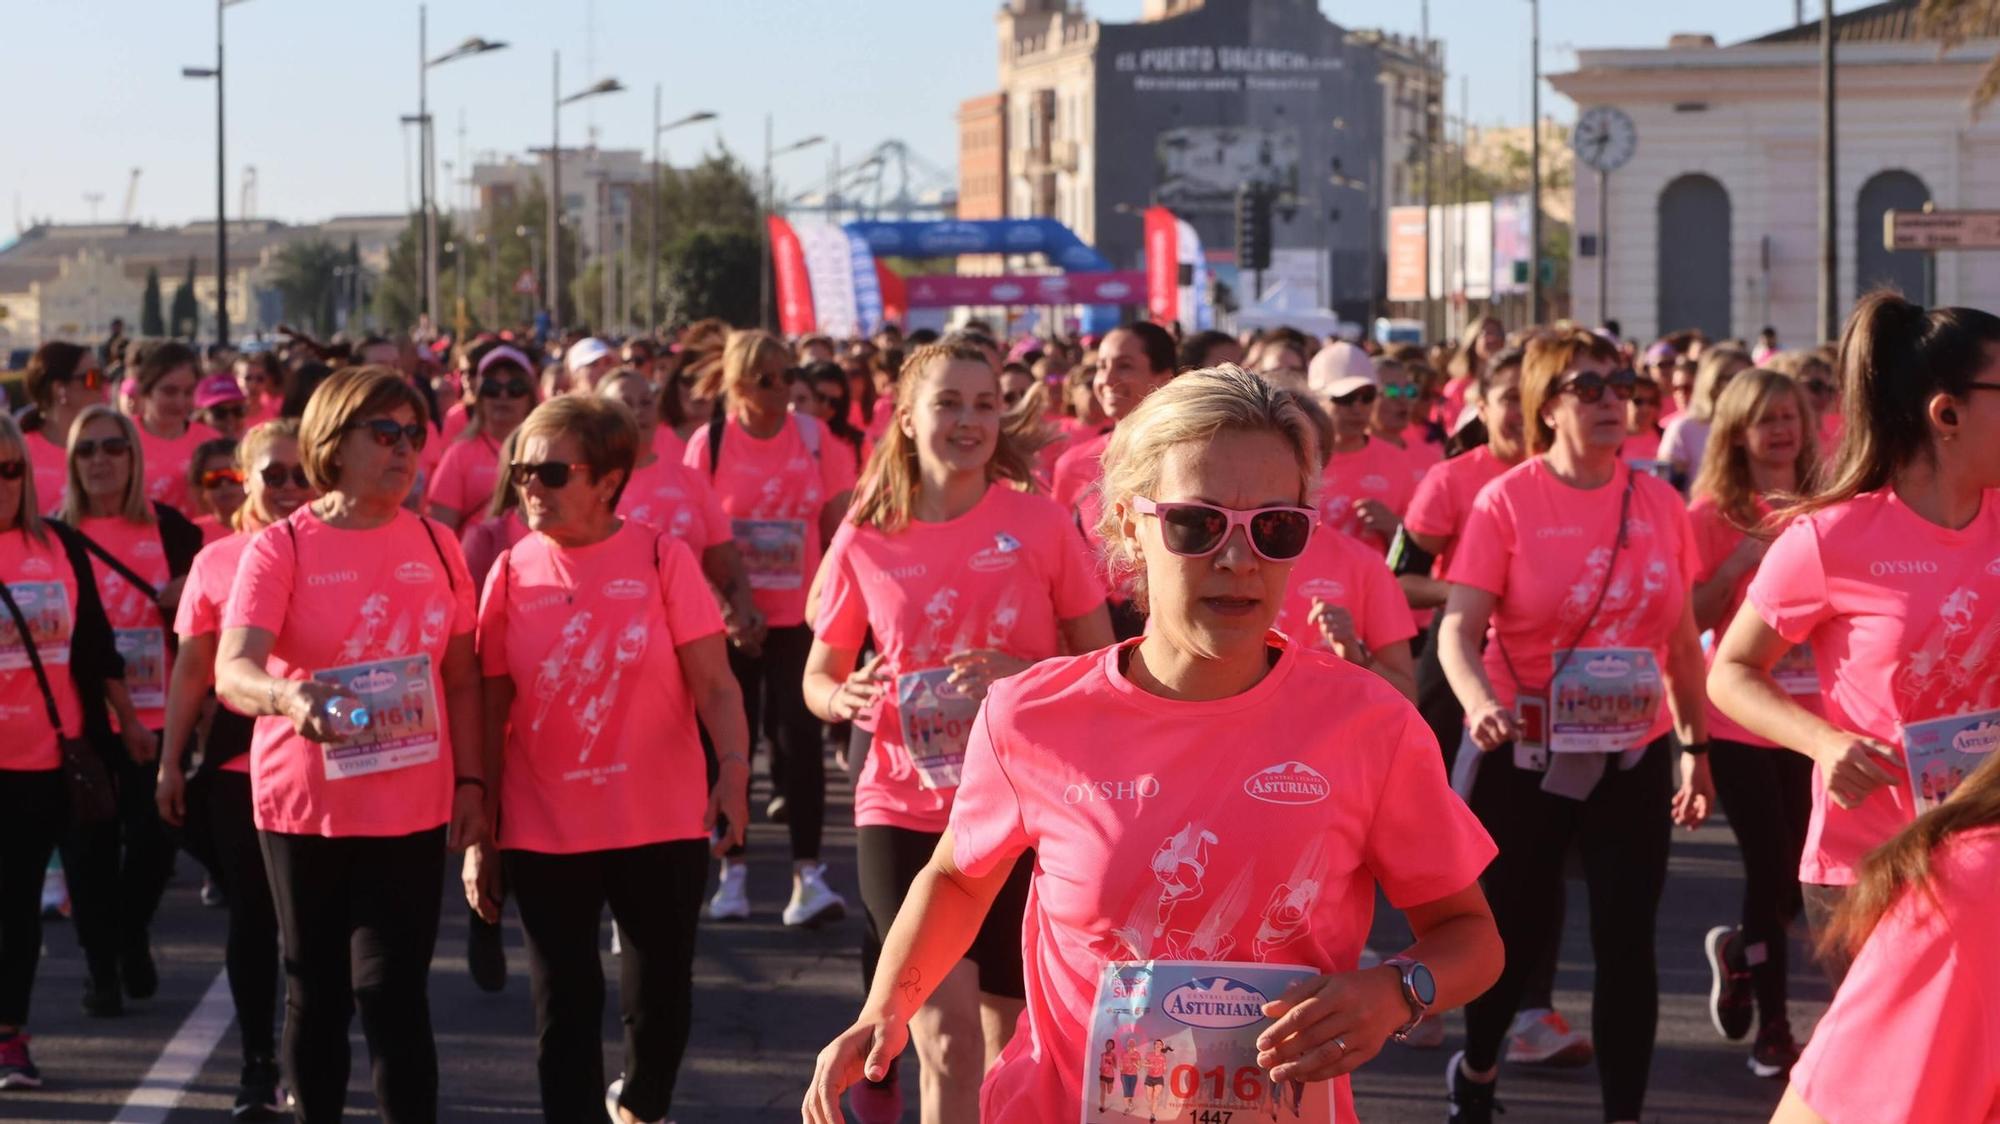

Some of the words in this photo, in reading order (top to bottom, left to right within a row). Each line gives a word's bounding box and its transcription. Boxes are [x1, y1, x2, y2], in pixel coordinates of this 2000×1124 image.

[1870, 561, 1938, 577] OYSHO
[1064, 775, 1160, 805] OYSHO
[1252, 778, 1324, 795] ASTURIANA
[1170, 994, 1263, 1016] ASTURIANA
[1170, 1064, 1262, 1101] 016
[1189, 1109, 1233, 1124] 1447
